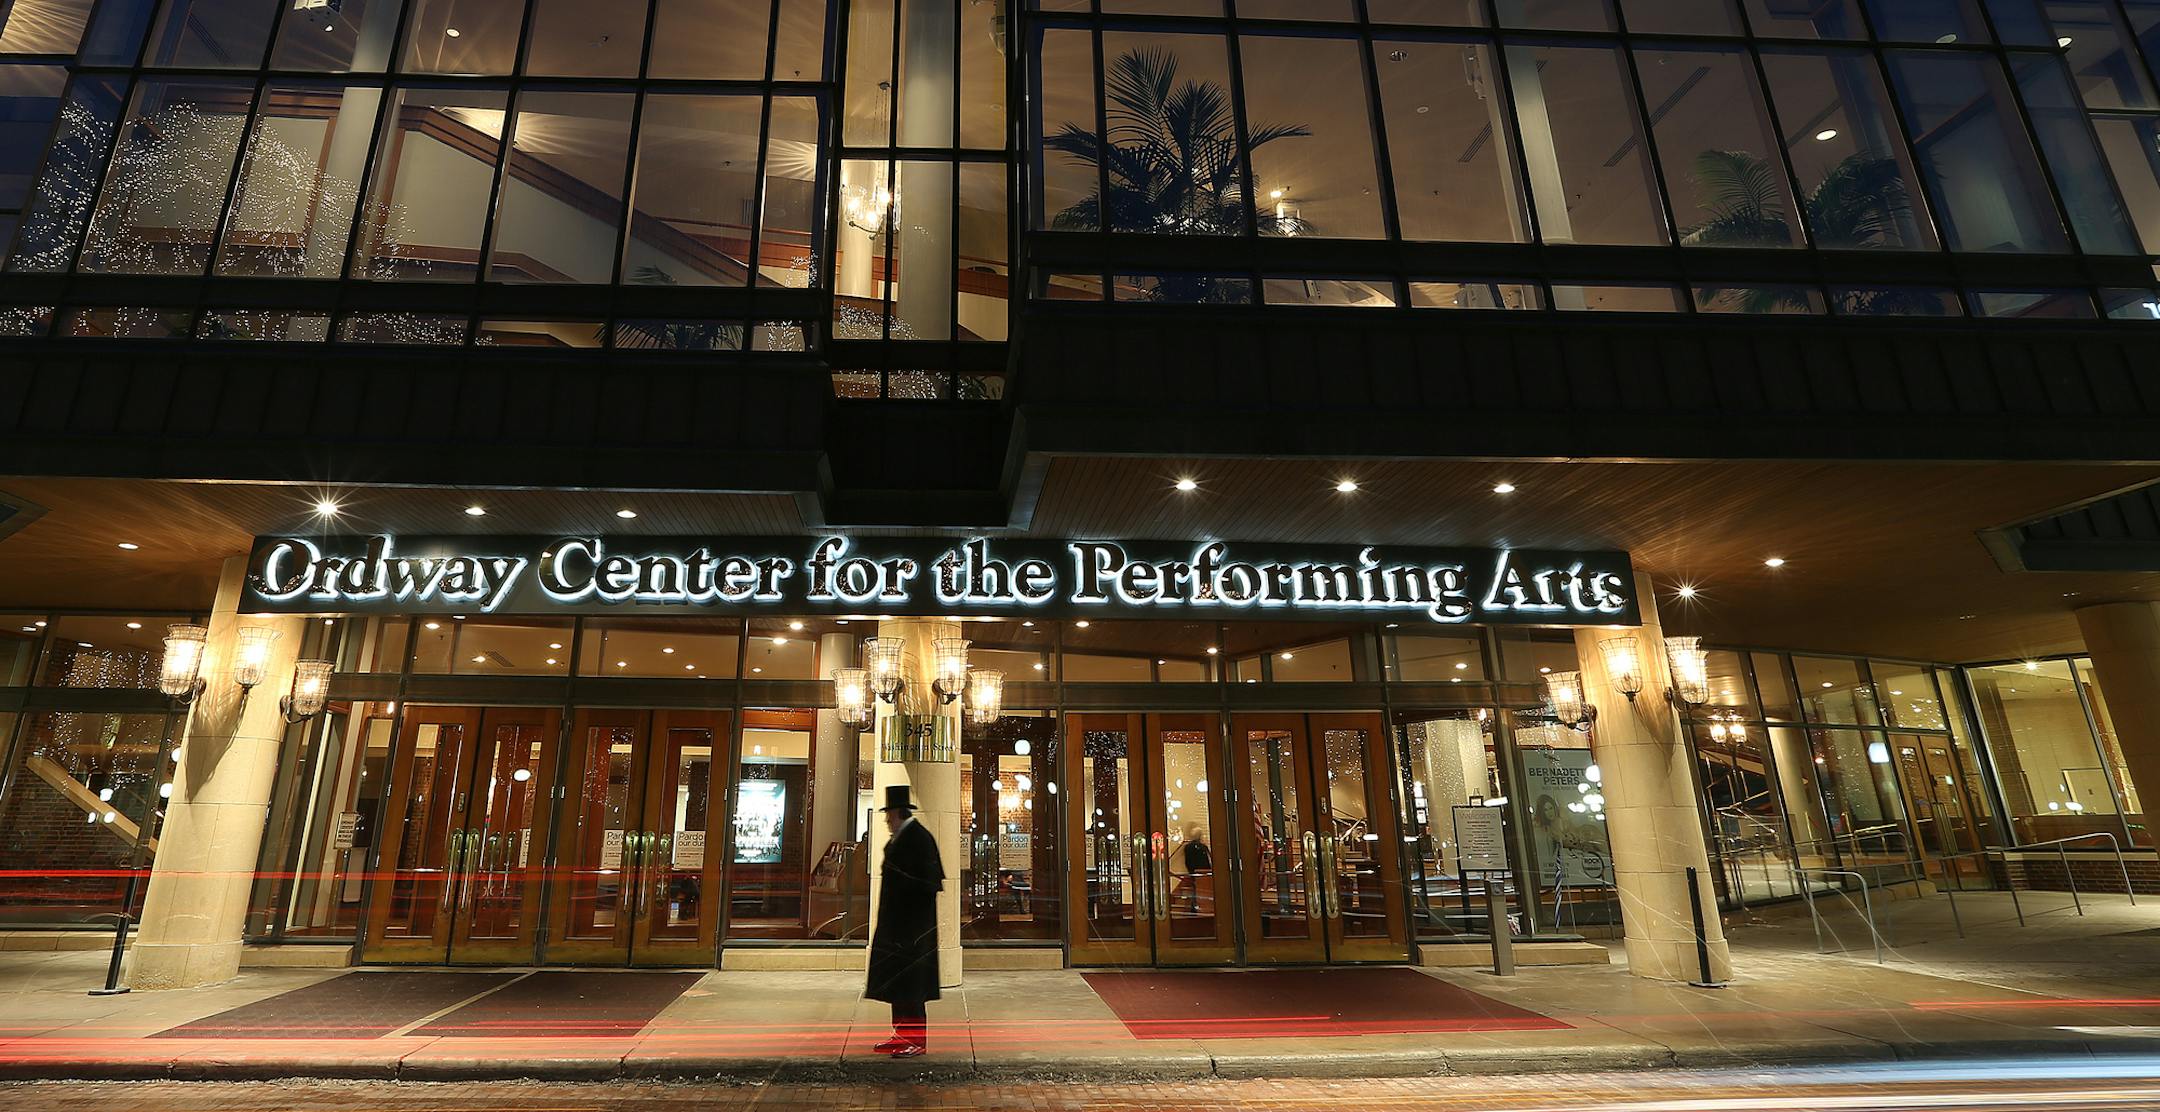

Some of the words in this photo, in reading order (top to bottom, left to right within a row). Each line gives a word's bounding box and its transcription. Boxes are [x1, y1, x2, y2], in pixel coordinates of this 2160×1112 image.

[251, 535, 527, 612] Ordway
[538, 536, 796, 603] Center
[807, 535, 919, 601] for
[934, 538, 1055, 604] the
[1068, 540, 1473, 623] Performing
[1483, 549, 1627, 613] Arts
[905, 722, 933, 737] 345
[1529, 768, 1586, 776] BERNADETT
[1544, 777, 1580, 785] PETERS
[1002, 834, 1029, 842] Pardon
